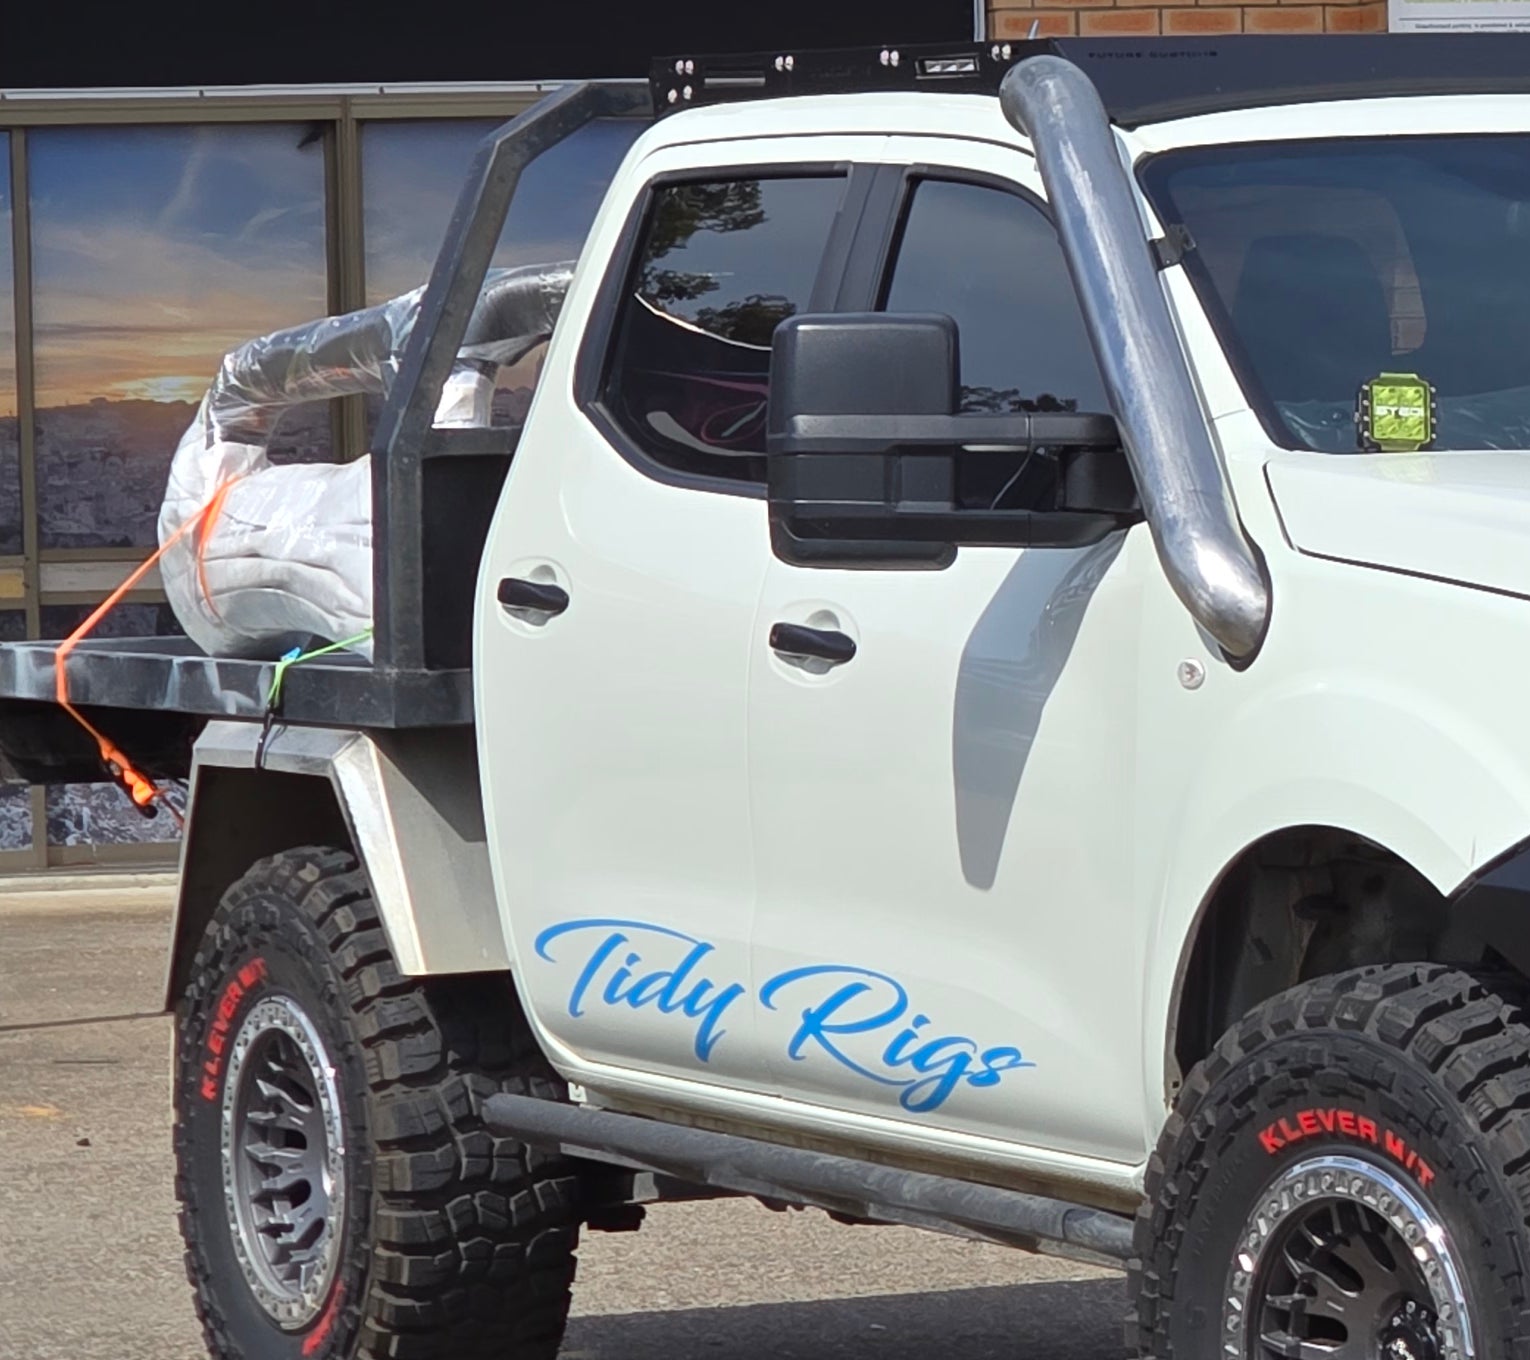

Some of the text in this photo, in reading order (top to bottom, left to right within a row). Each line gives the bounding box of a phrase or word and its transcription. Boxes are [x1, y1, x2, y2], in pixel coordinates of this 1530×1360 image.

[533, 917, 1037, 1114] Tidy Rigs
[1257, 1107, 1379, 1155] KLEVER
